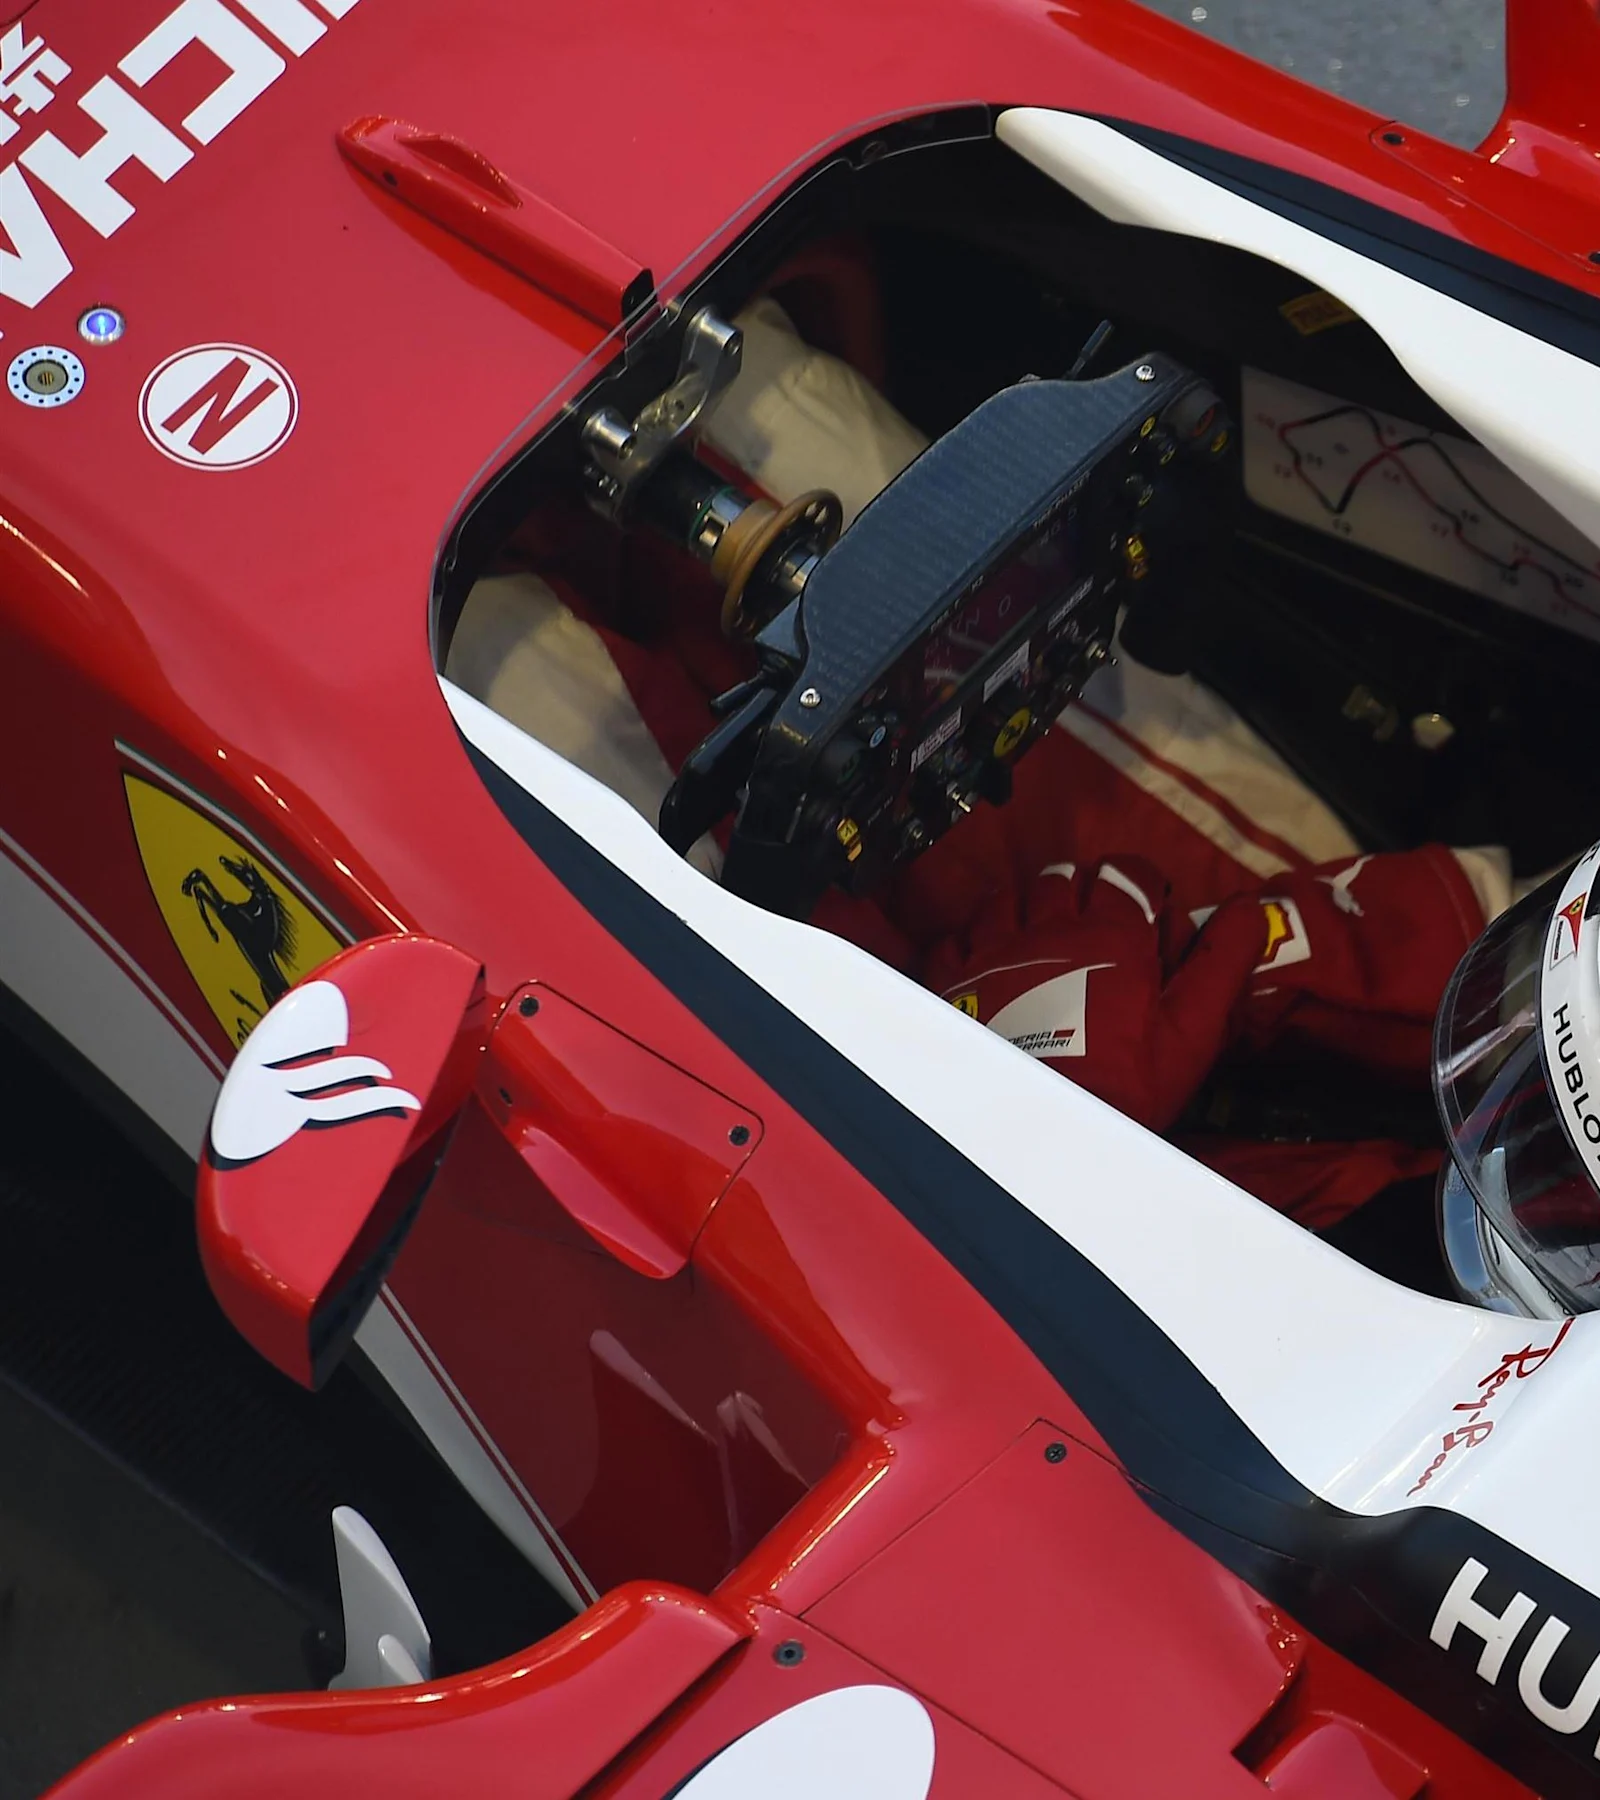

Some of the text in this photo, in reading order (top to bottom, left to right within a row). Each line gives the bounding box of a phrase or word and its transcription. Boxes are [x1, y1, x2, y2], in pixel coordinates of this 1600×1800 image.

[0, 0, 361, 309] ICHA
[161, 355, 280, 455] N
[1008, 1031, 1051, 1044] DERIA
[1017, 1039, 1071, 1051] RRARI
[1406, 1316, 1577, 1497] Ray-Ban
